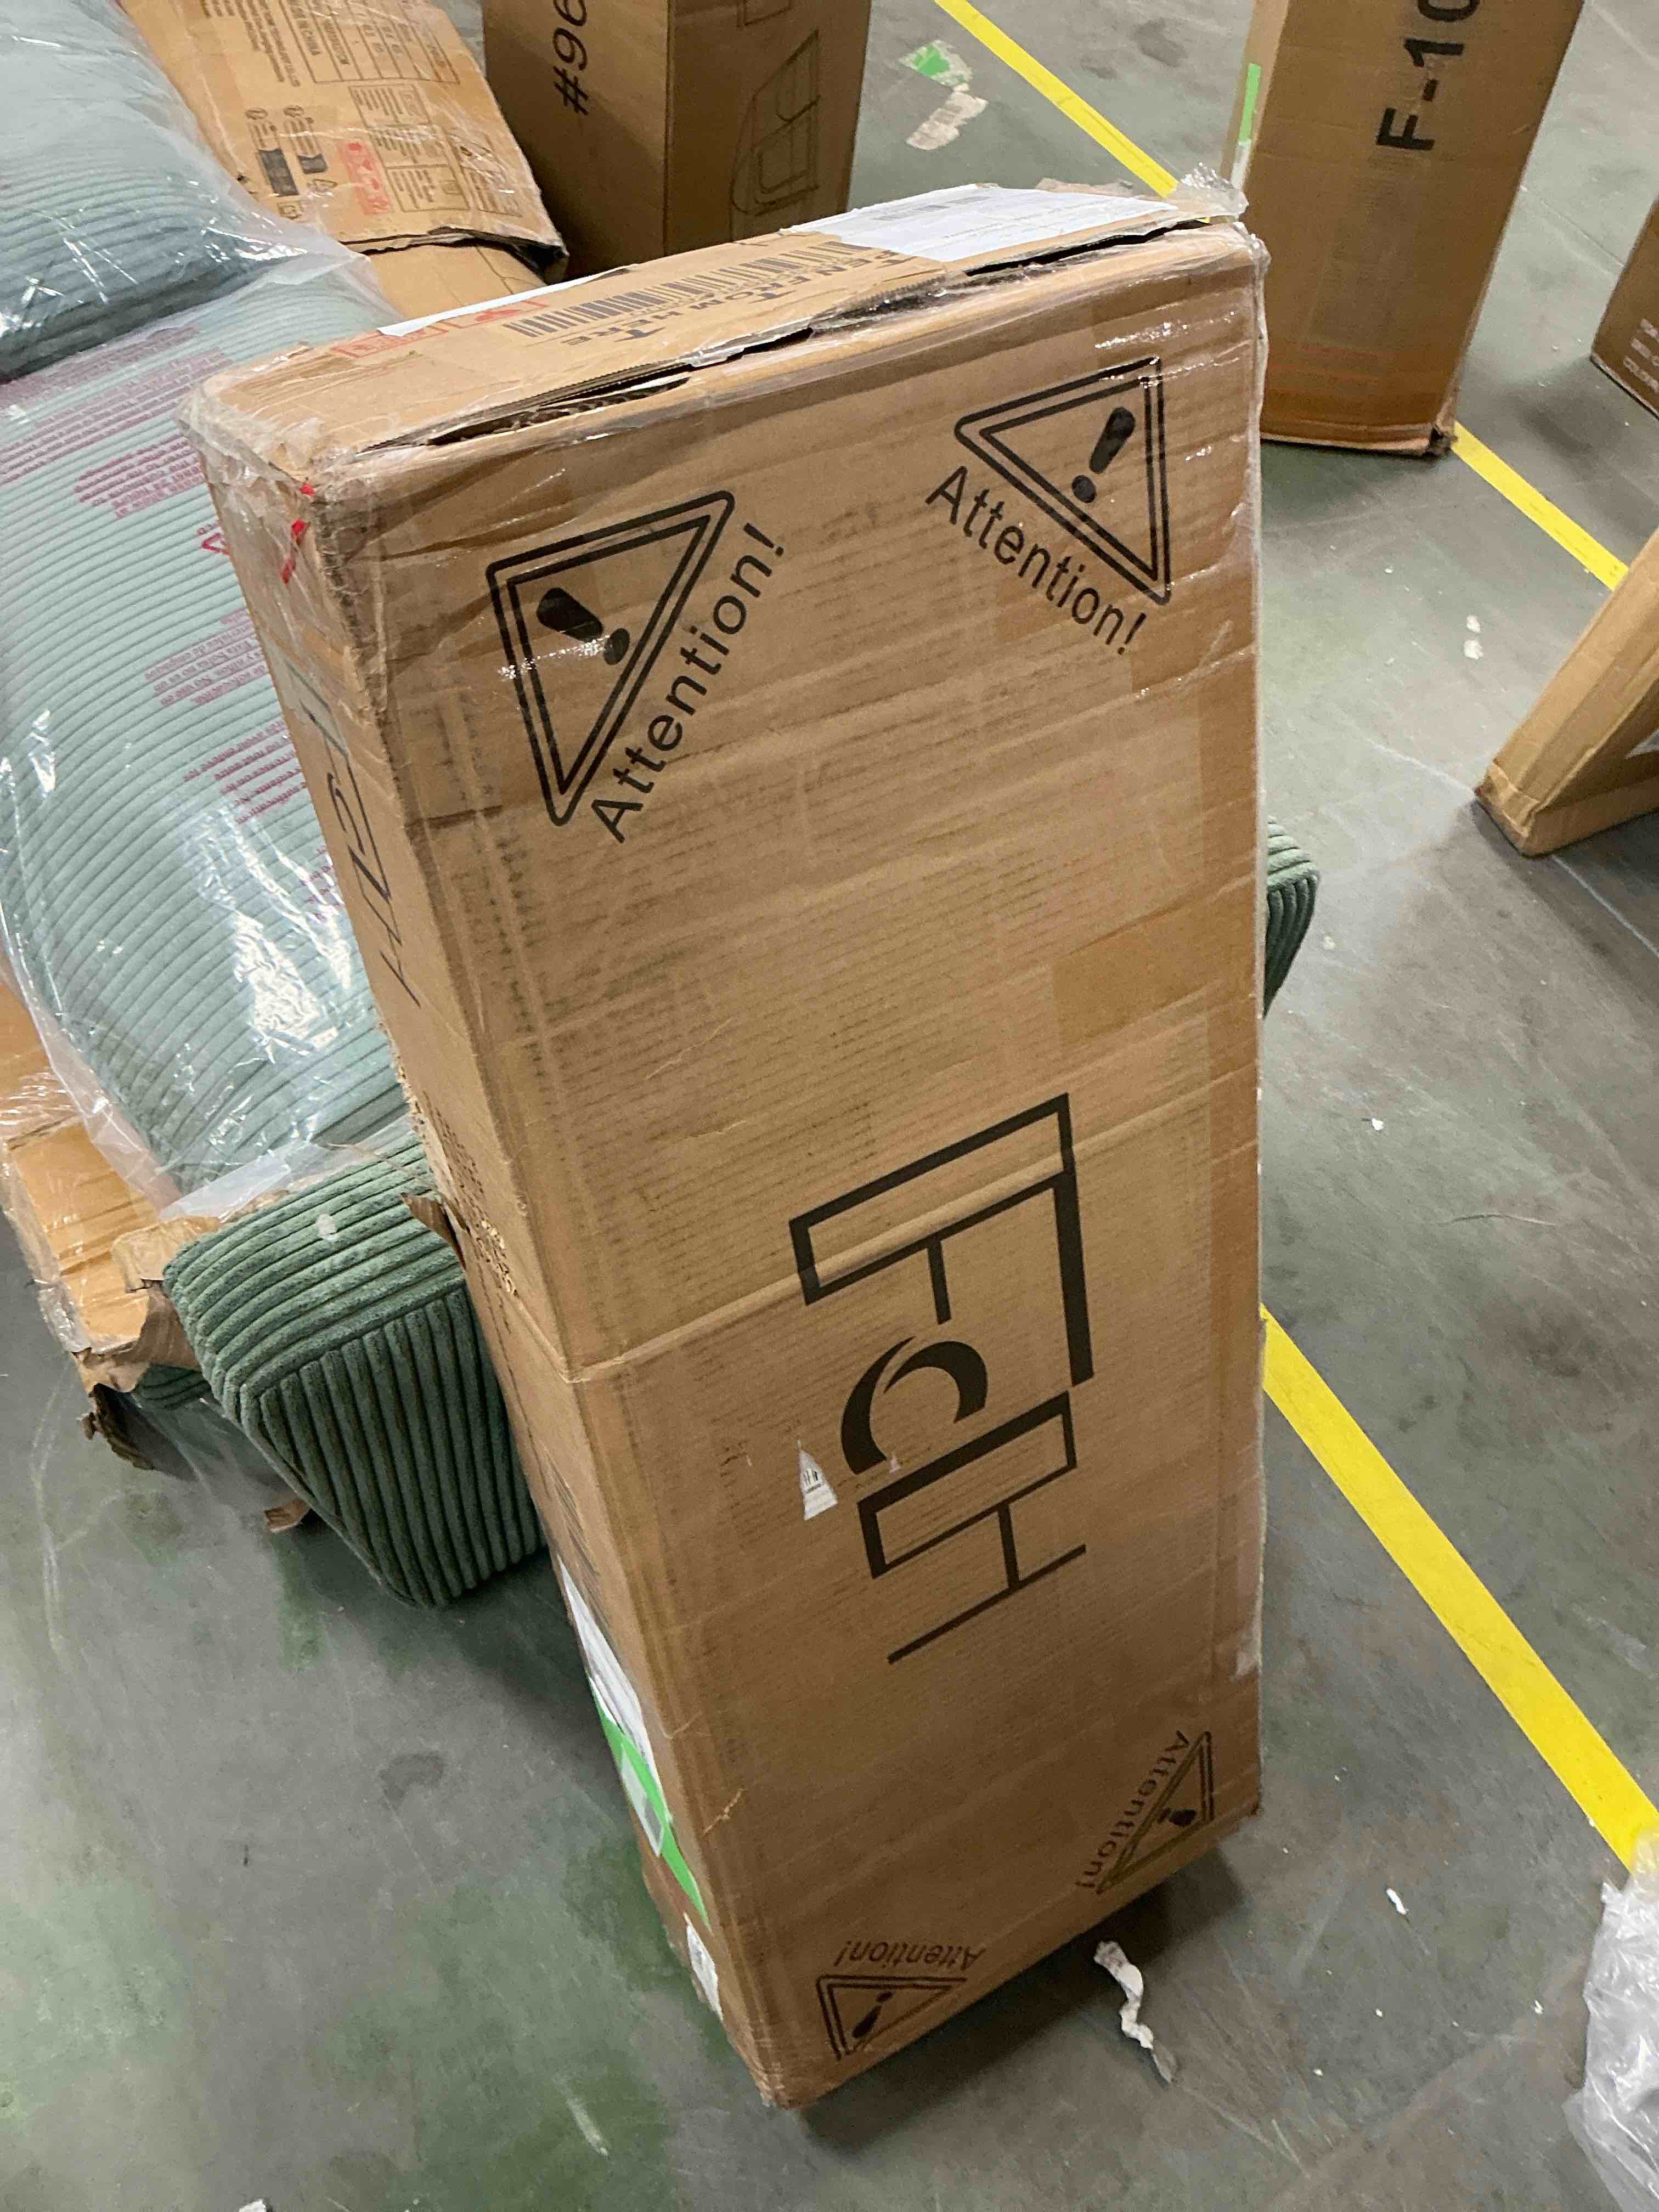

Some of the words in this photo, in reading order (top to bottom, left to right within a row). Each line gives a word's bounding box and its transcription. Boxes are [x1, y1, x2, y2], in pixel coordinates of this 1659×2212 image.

[819, 250, 898, 276] PEN
[690, 276, 812, 311] FROM
[562, 311, 682, 346] HERE
[924, 465, 1146, 655] Attention!
[591, 522, 785, 843] Attention!
[1074, 1730, 1189, 1890] Attention!
[834, 1939, 986, 1971] Attention!
